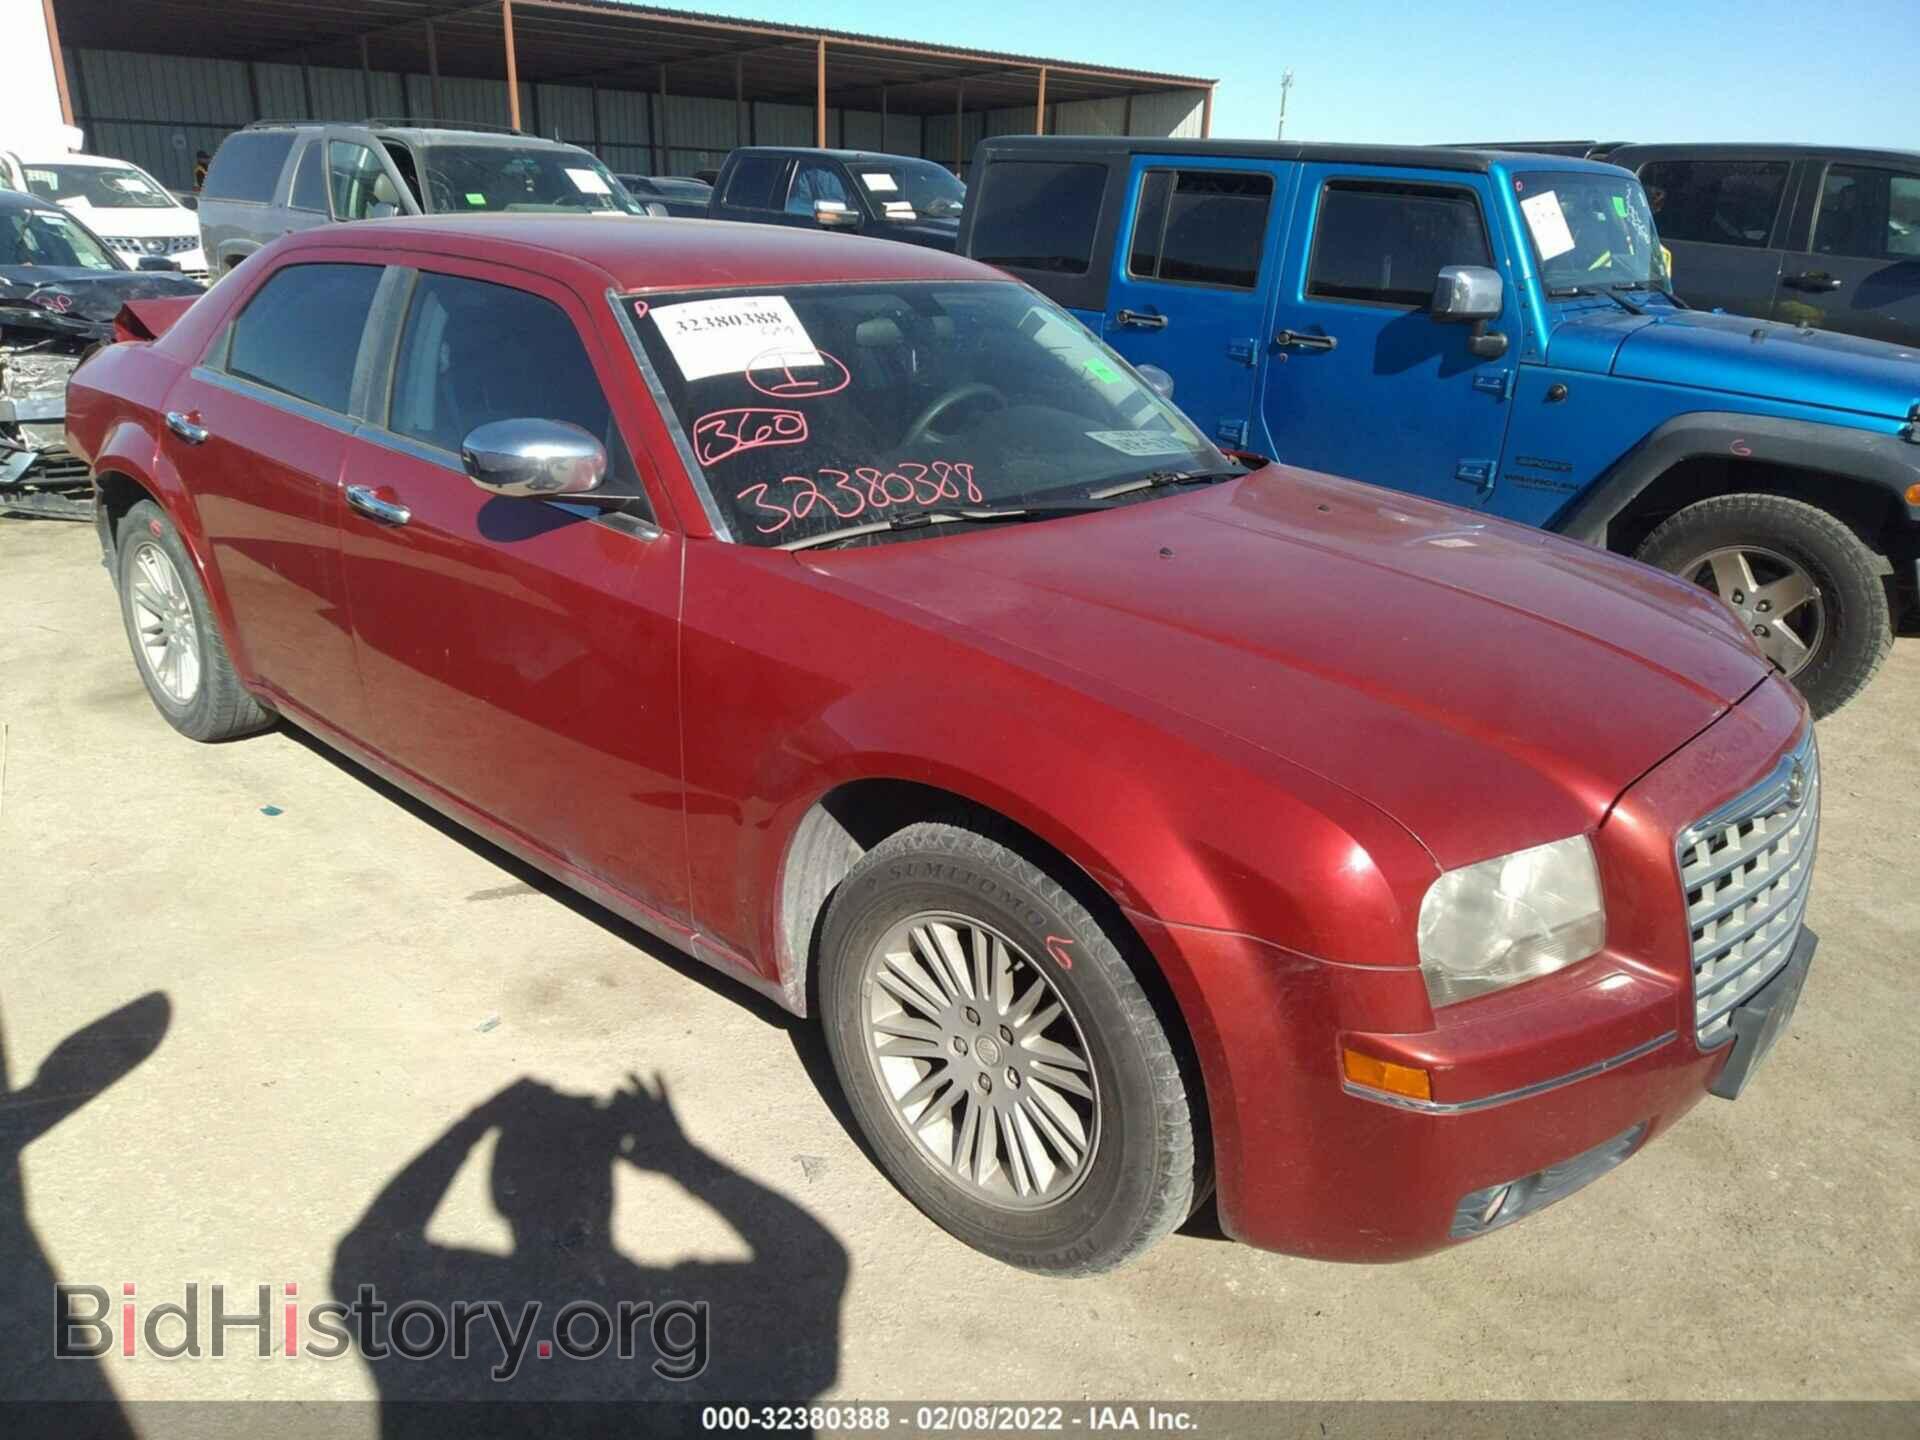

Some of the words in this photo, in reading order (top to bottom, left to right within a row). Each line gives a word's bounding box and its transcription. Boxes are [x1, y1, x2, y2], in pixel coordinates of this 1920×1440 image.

[676, 311, 783, 336] 32380388
[698, 412, 803, 461] 360
[736, 461, 983, 534] 32380388
[888, 861, 1047, 927] SUMITOMO
